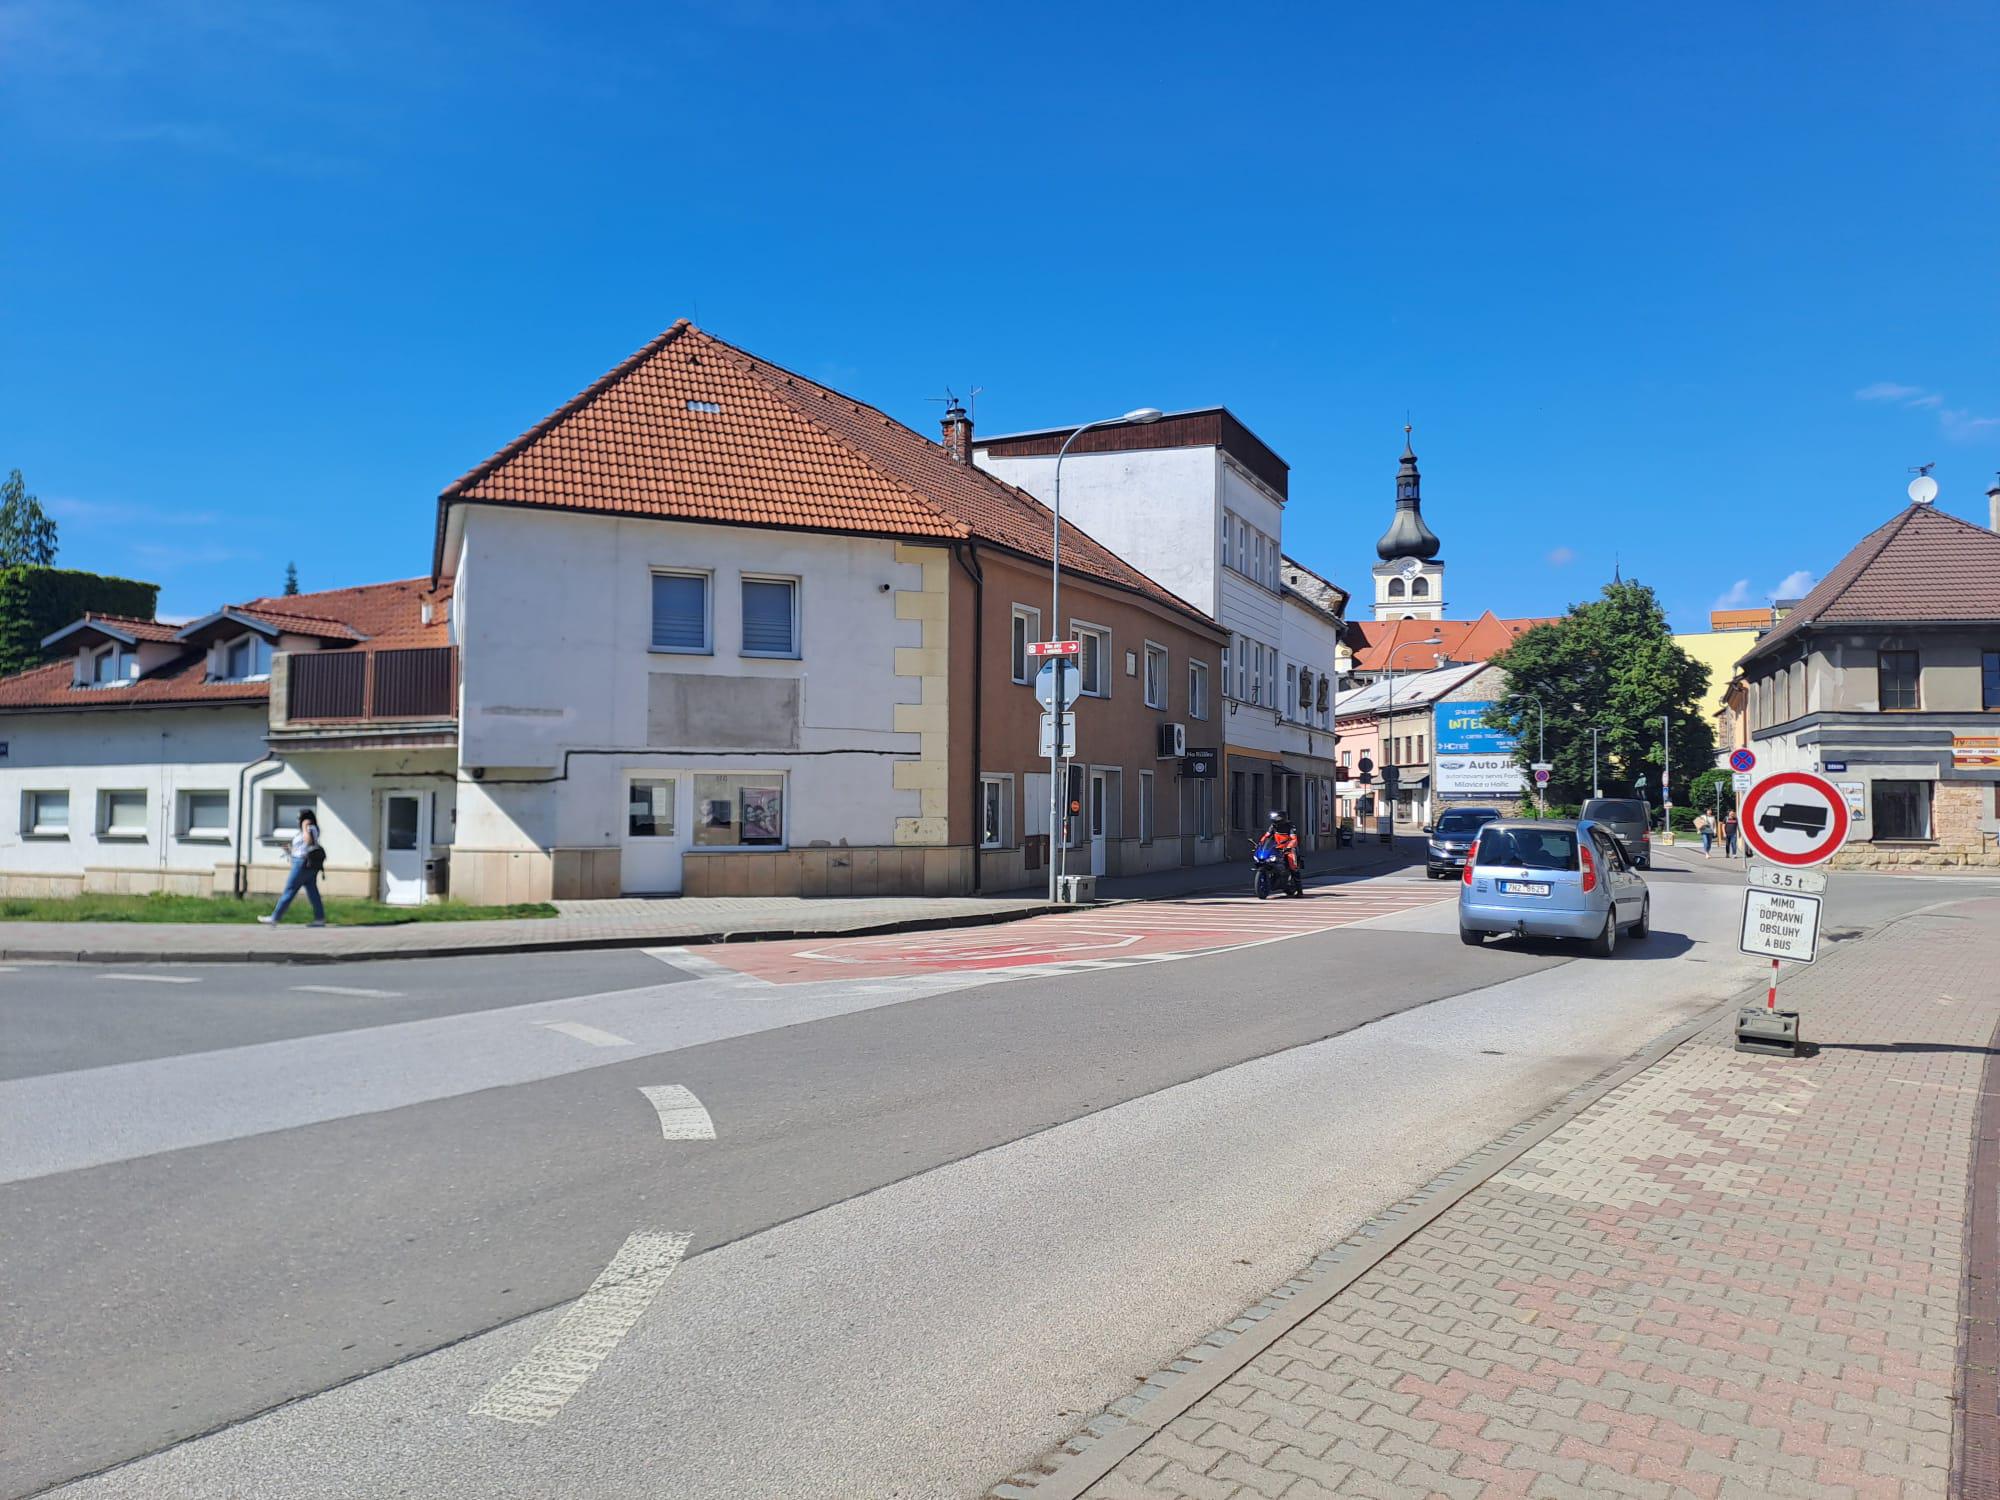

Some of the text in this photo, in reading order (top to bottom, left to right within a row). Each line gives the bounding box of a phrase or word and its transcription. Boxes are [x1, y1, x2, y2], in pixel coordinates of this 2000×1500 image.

[1469, 761, 1498, 769] Auto
[1772, 873, 1803, 888] 3.5 t
[1770, 897, 1795, 909] MIMO
[1759, 909, 1804, 924] DOPRAVNÍ
[1759, 923, 1800, 937] OBSLUHY
[1764, 938, 1792, 950] A BUS
